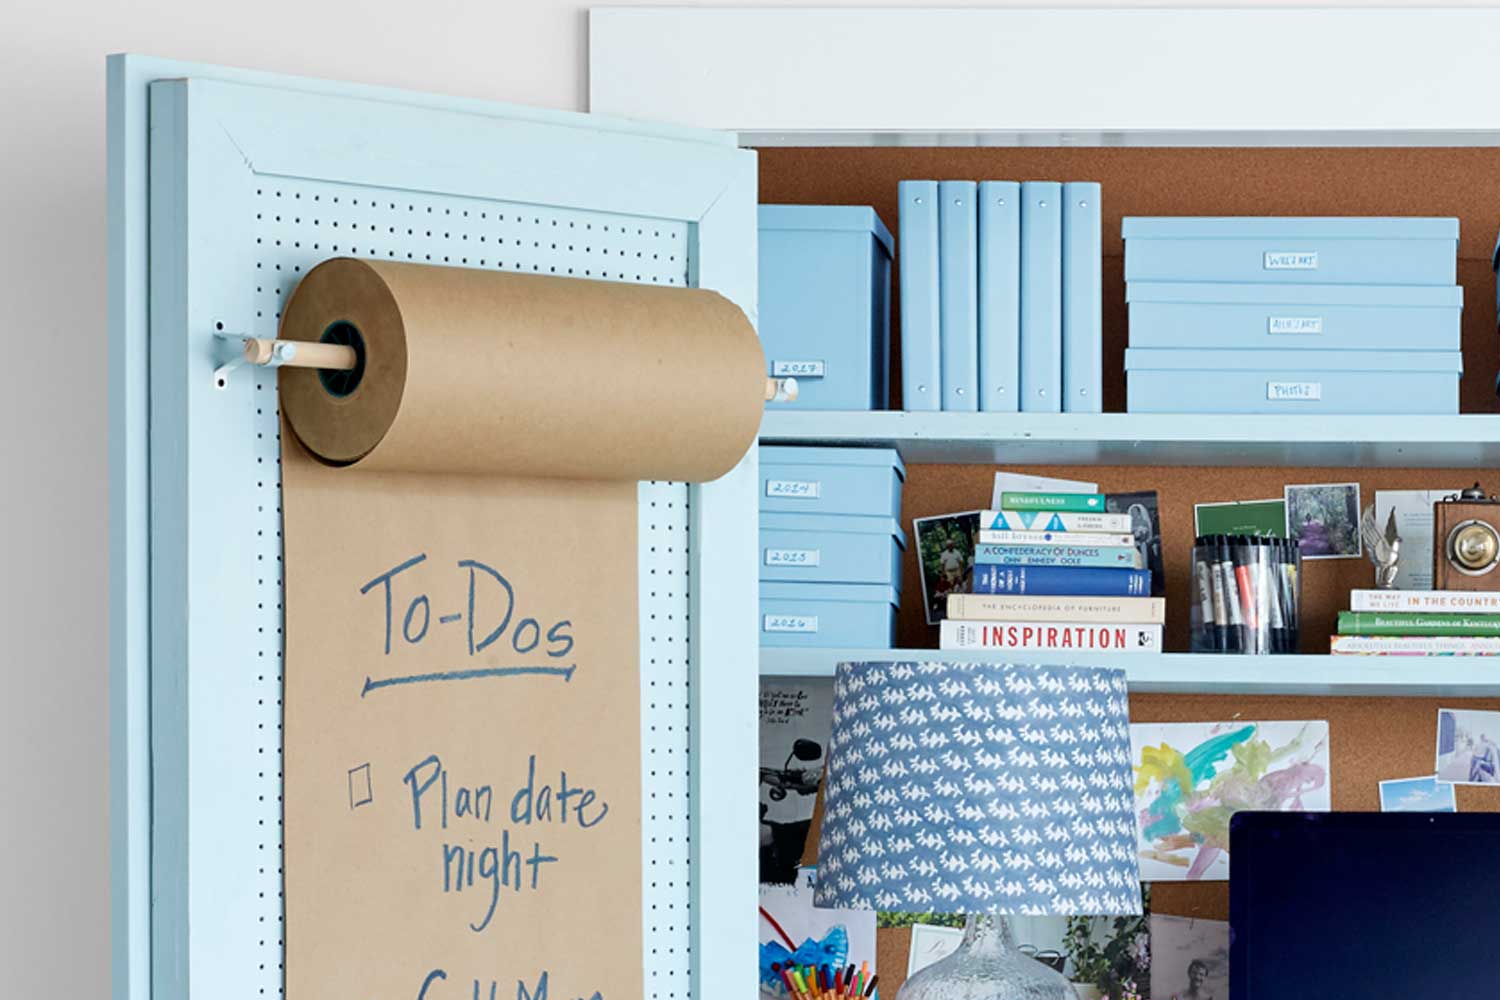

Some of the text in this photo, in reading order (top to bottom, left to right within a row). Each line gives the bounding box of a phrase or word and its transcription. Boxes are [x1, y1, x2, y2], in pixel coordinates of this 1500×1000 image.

[780, 364, 817, 374] 2017
[992, 546, 1052, 556] CONFEDERACY
[360, 553, 575, 658] To-Dos
[1000, 603, 1061, 611] ENCYCLOPEDIA
[1078, 604, 1121, 613] FURNITURE
[1407, 597, 1420, 606] IN
[1424, 597, 1446, 606] THE
[982, 625, 1127, 649] INSPIRATION
[403, 755, 609, 830] Plan date
[443, 830, 559, 932] night
